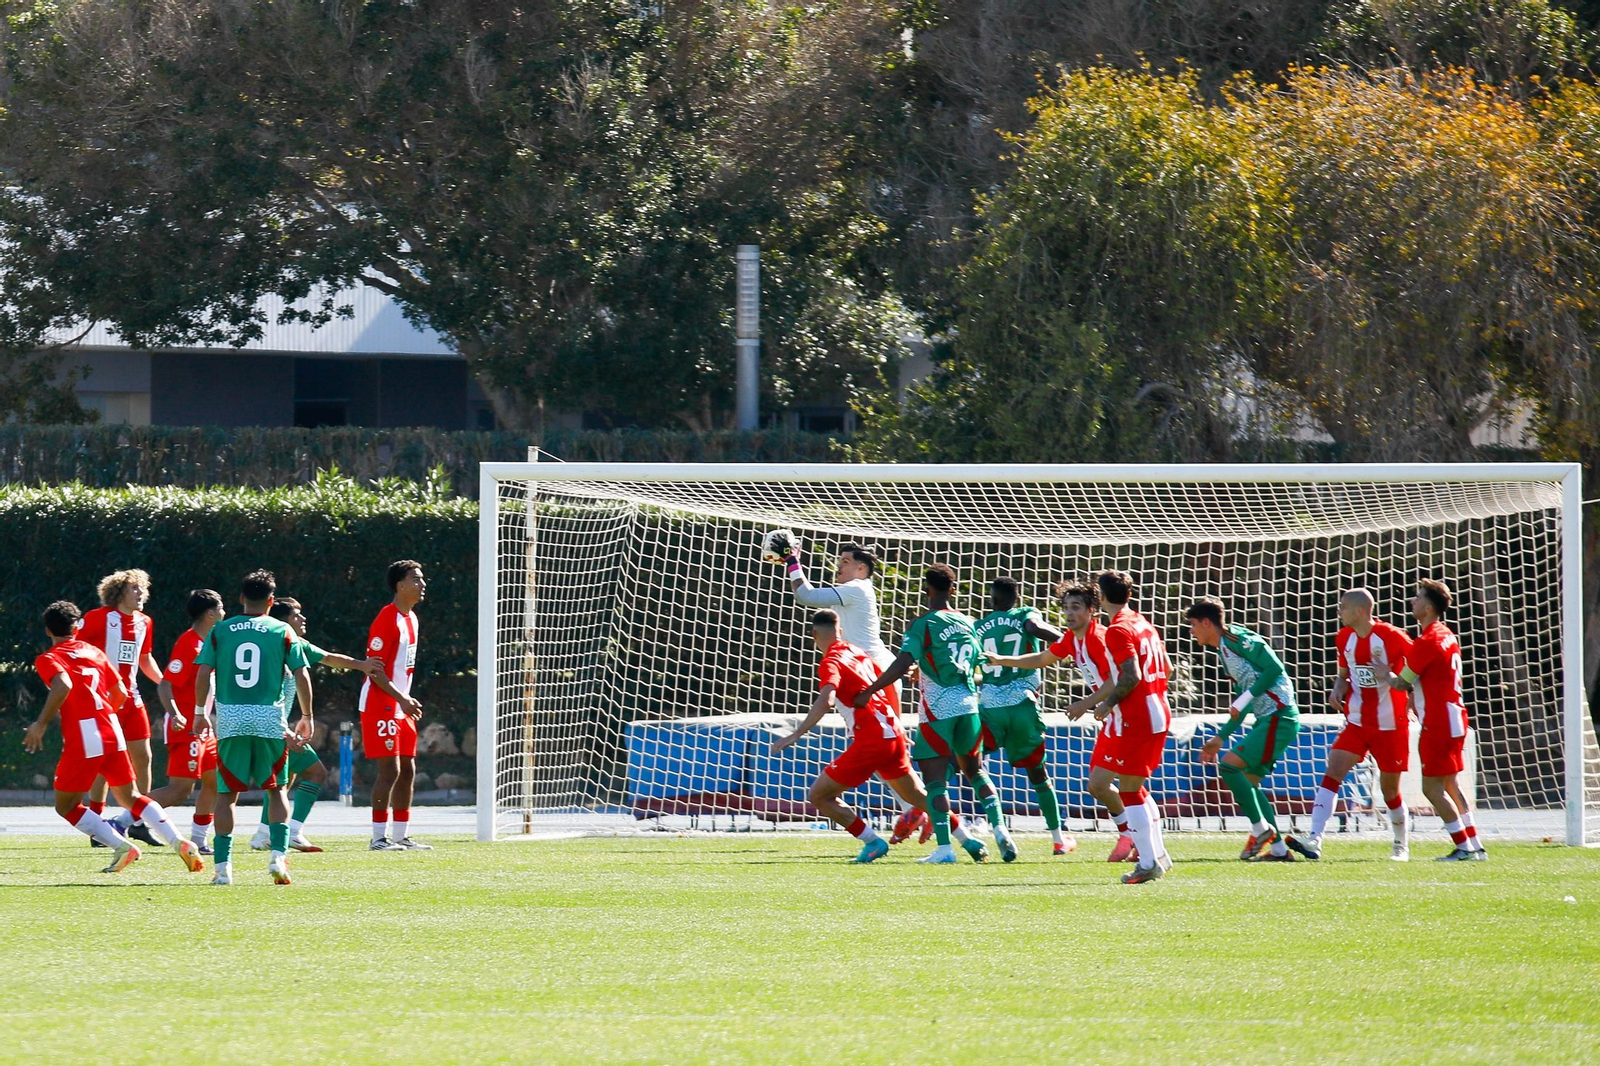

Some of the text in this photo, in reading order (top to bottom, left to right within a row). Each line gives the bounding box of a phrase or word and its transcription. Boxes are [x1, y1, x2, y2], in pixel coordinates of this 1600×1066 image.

[235, 642, 261, 689] 9
[982, 632, 1023, 678] 47
[81, 667, 104, 711] 7
[189, 741, 199, 757] 8
[376, 719, 398, 737] 26
